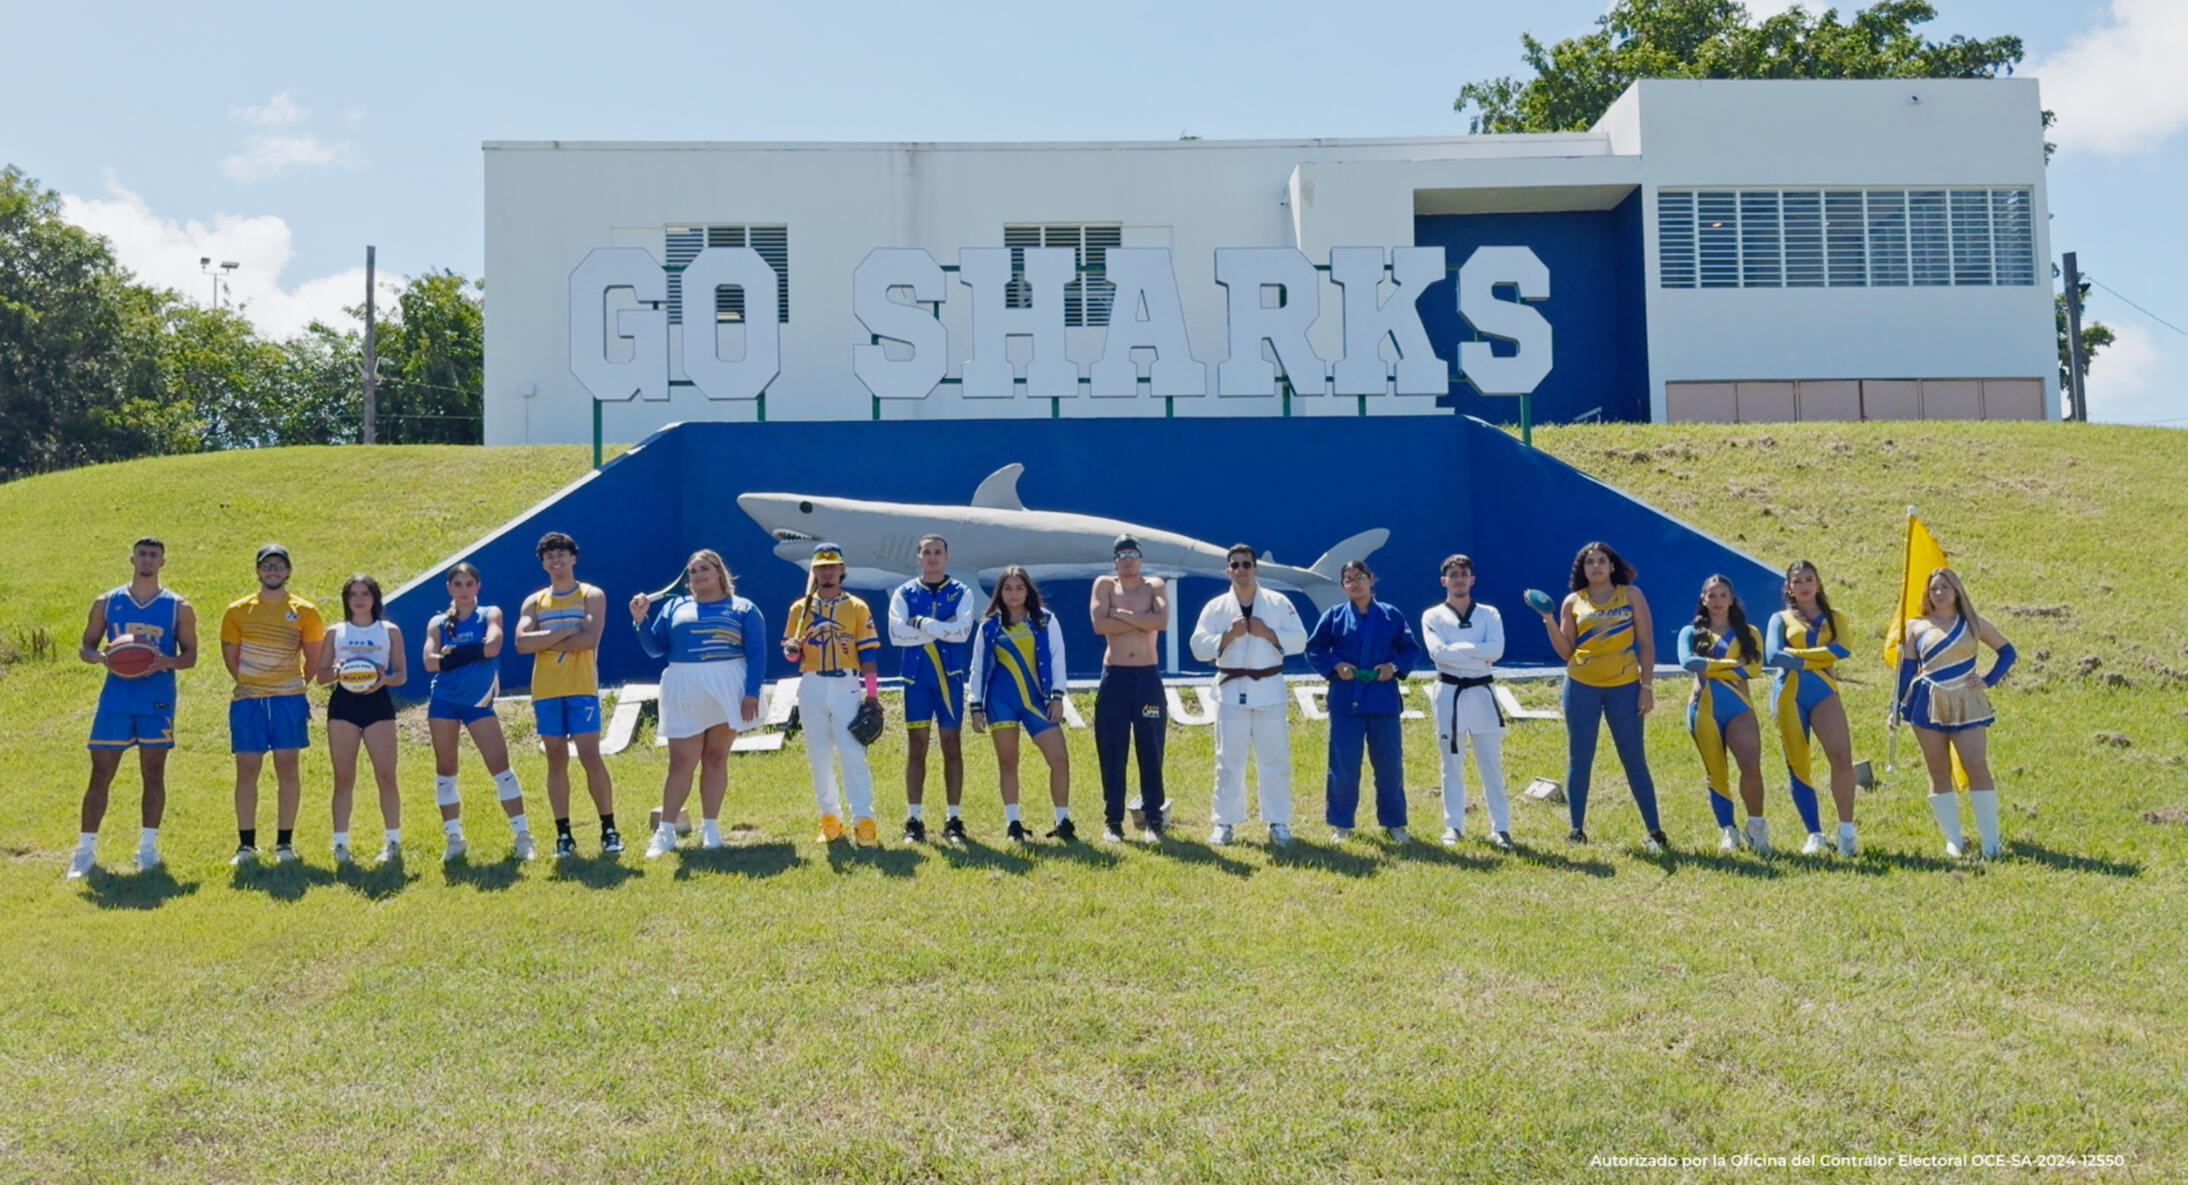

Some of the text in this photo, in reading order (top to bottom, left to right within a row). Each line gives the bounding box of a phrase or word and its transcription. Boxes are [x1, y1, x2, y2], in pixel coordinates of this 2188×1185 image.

[569, 245, 1554, 402] GO SHARKS
[584, 705, 595, 723] 7
